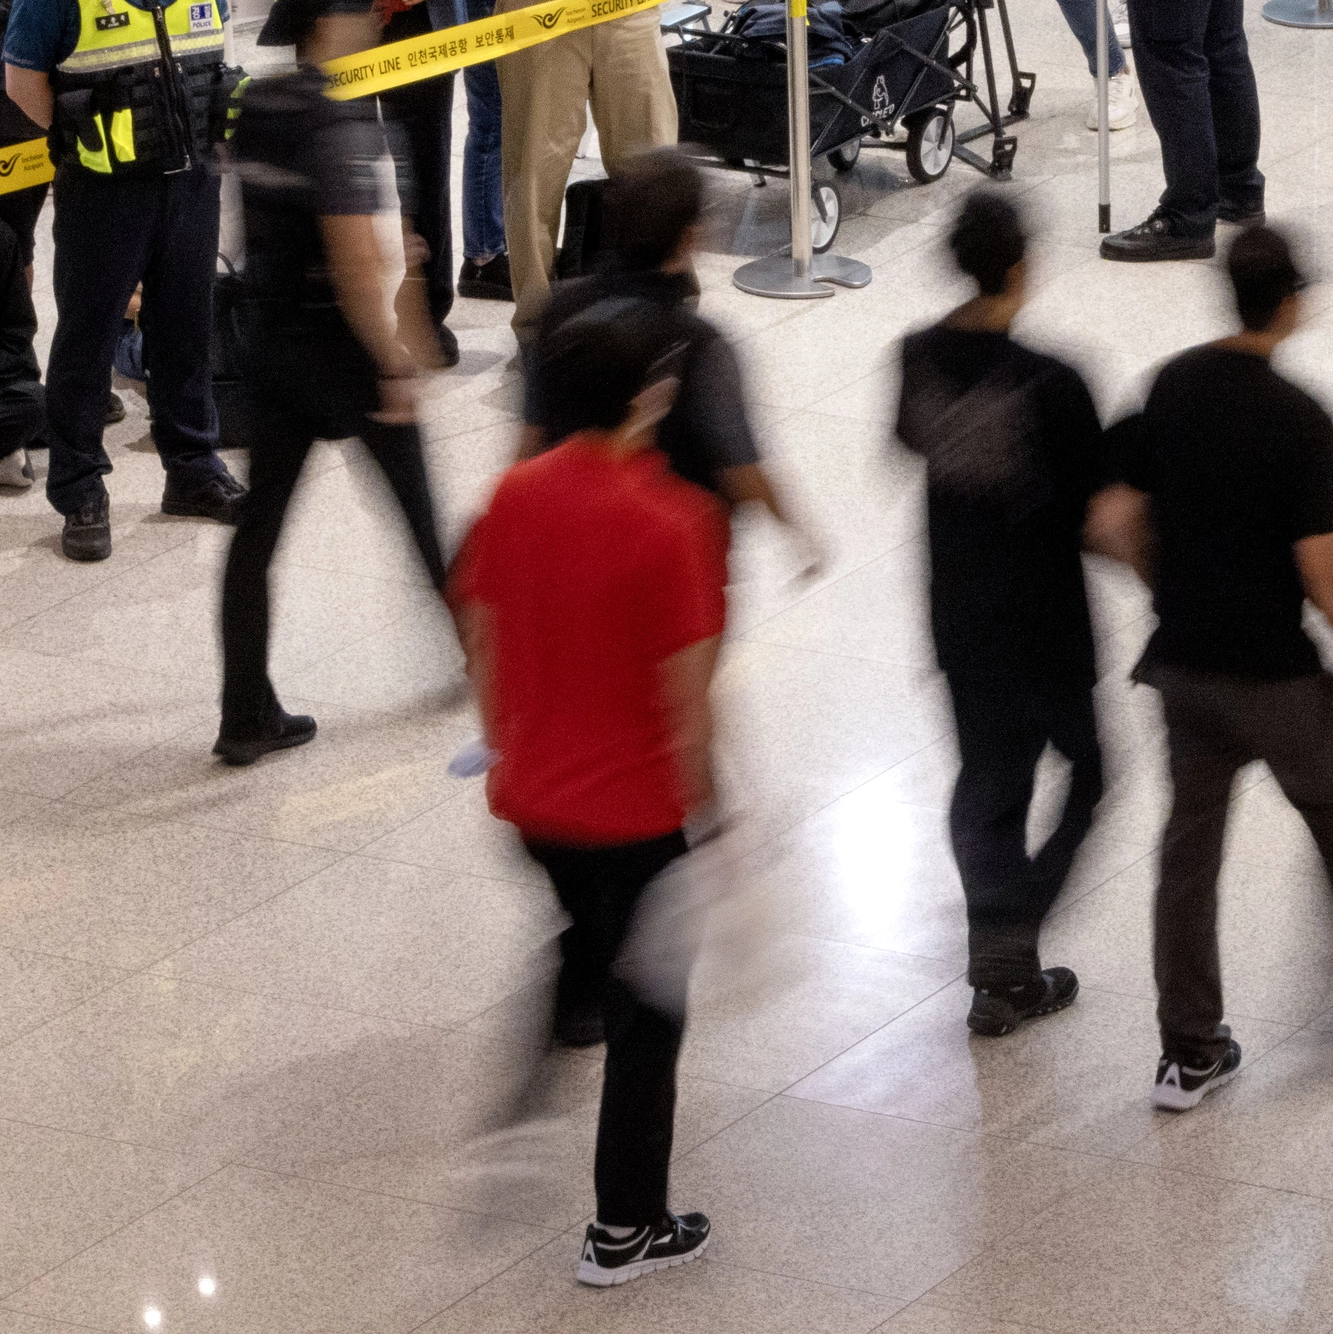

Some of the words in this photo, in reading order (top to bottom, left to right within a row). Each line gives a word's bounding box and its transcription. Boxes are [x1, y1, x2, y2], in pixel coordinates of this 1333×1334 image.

[192, 21, 212, 29] POLICE
[328, 63, 375, 90] SECURITY
[378, 56, 402, 75] LINE
[407, 38, 468, 68] 인천국제공항
[475, 25, 515, 49] 보안통제
